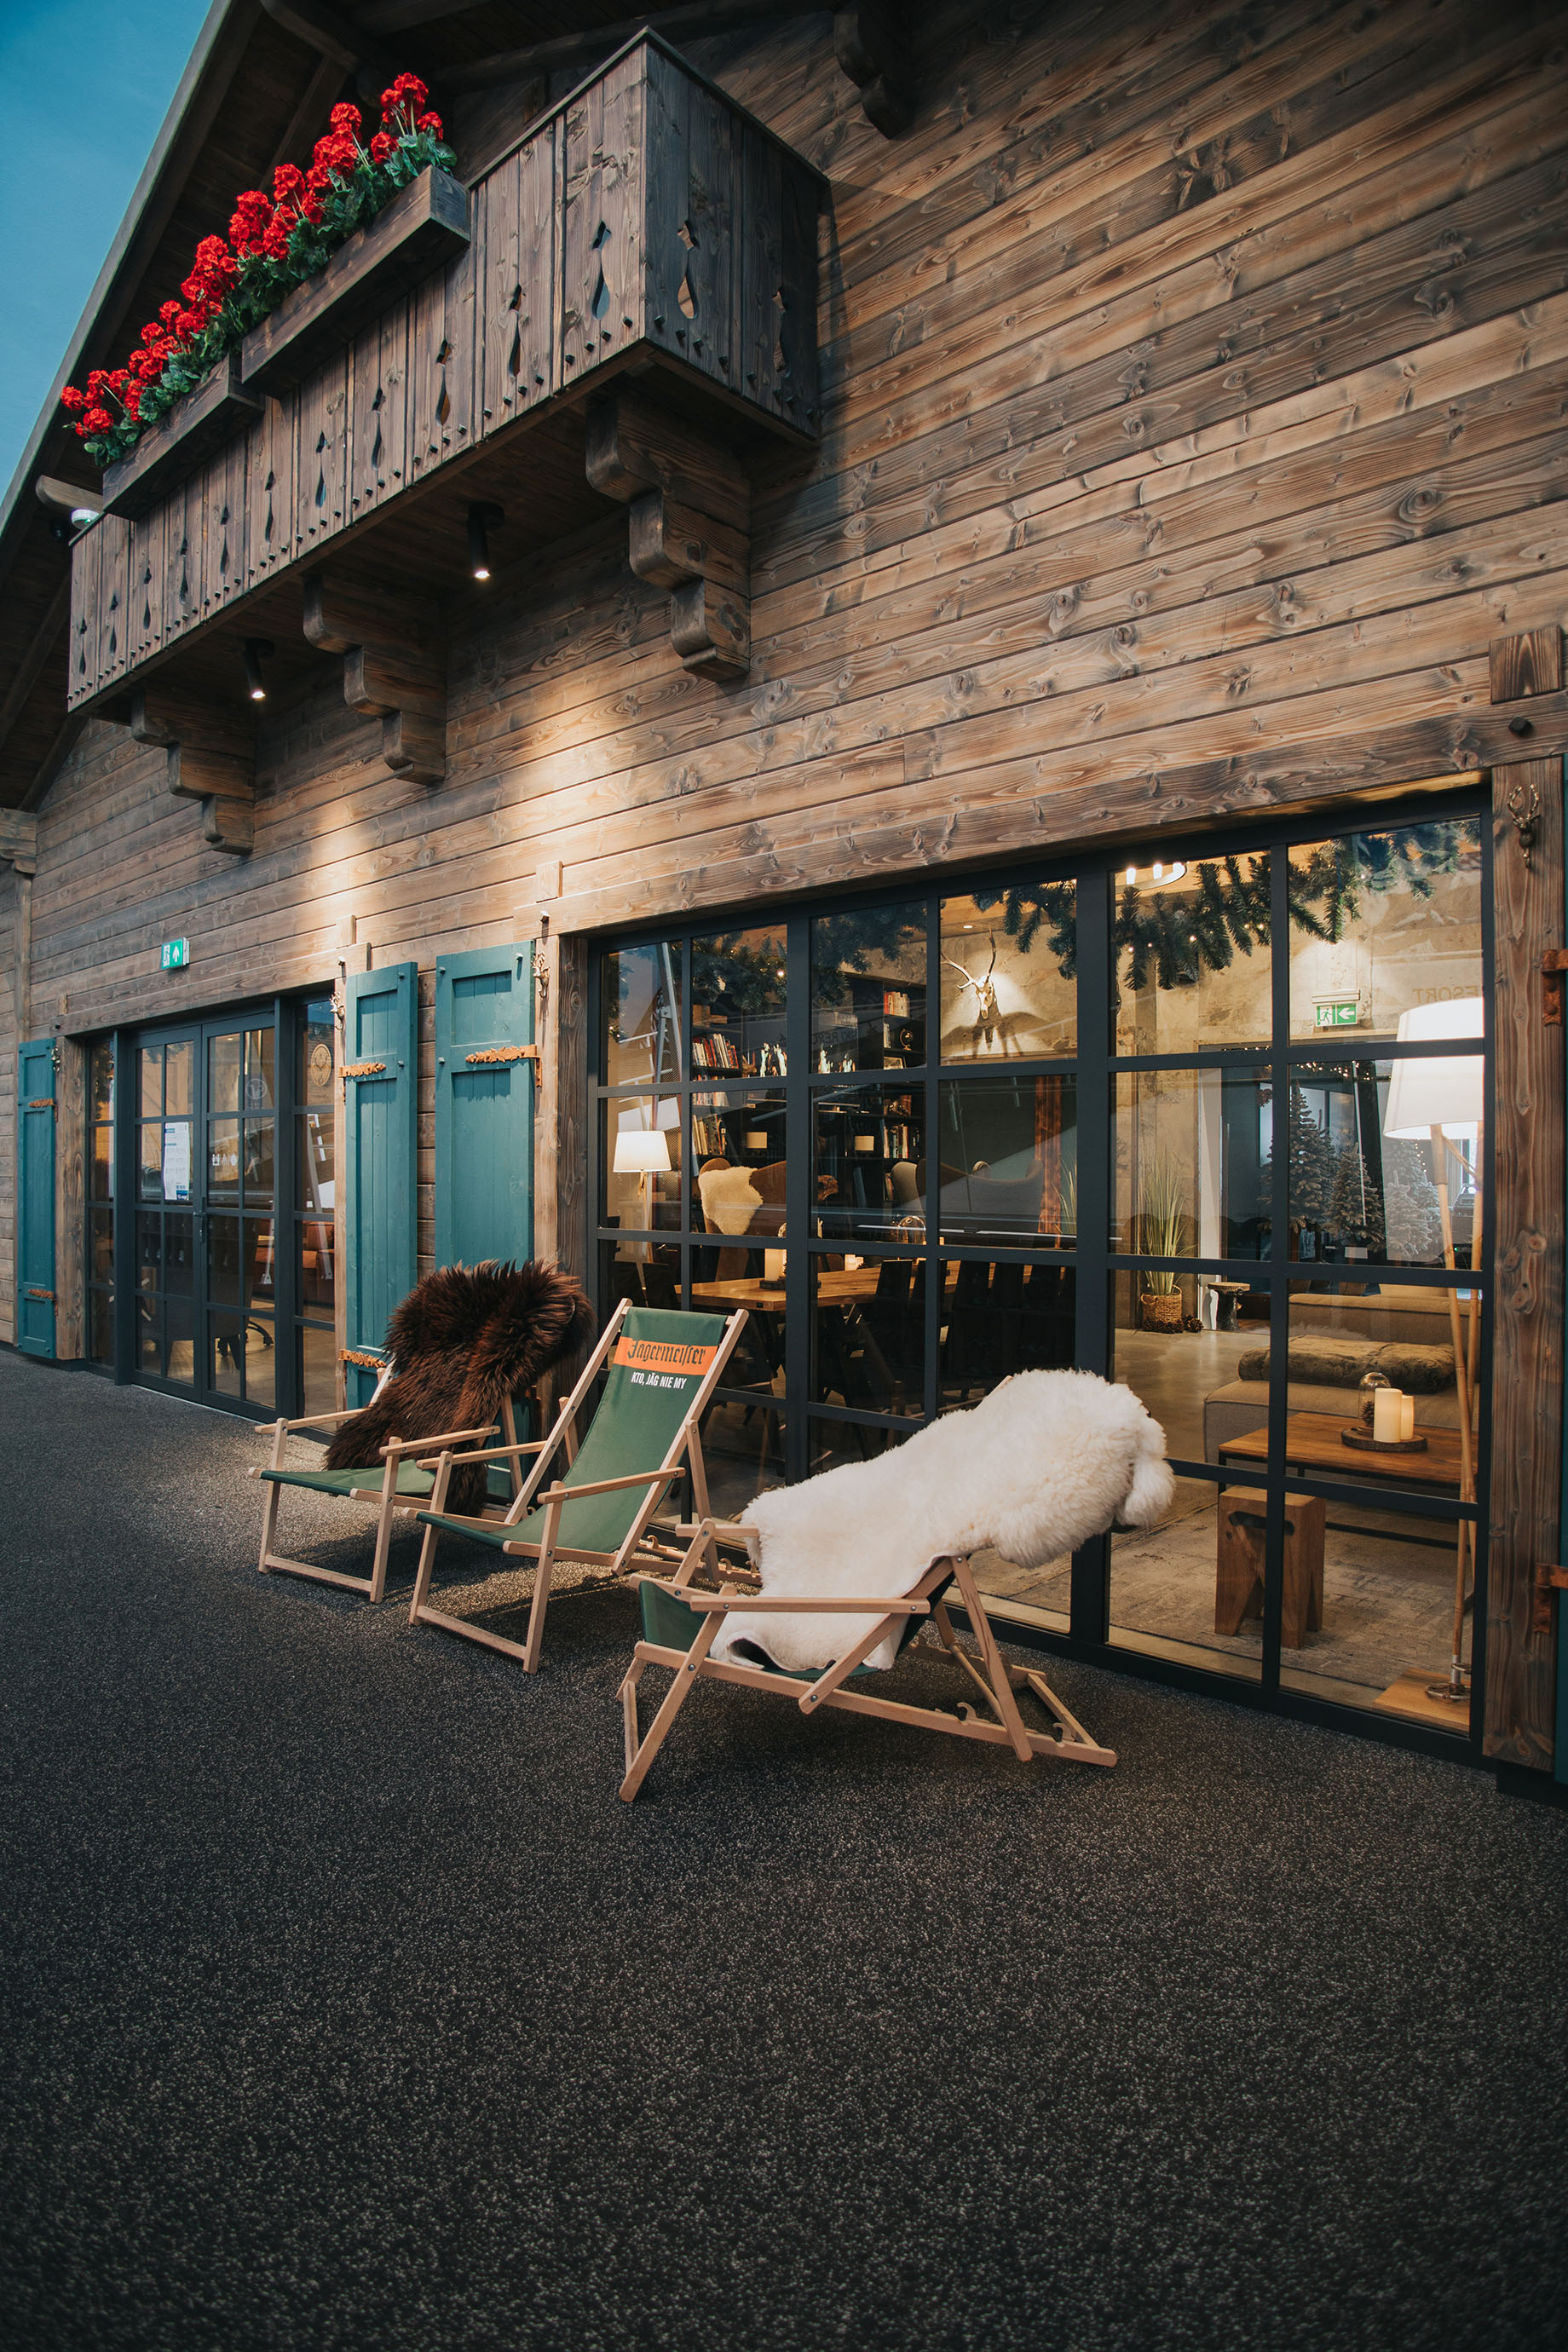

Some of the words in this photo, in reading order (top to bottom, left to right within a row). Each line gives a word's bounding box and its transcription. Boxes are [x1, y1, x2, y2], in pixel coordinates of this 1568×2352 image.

[631, 1371, 645, 1386] KTO,
[660, 1376, 673, 1387] NIE
[673, 1377, 687, 1390] MY
